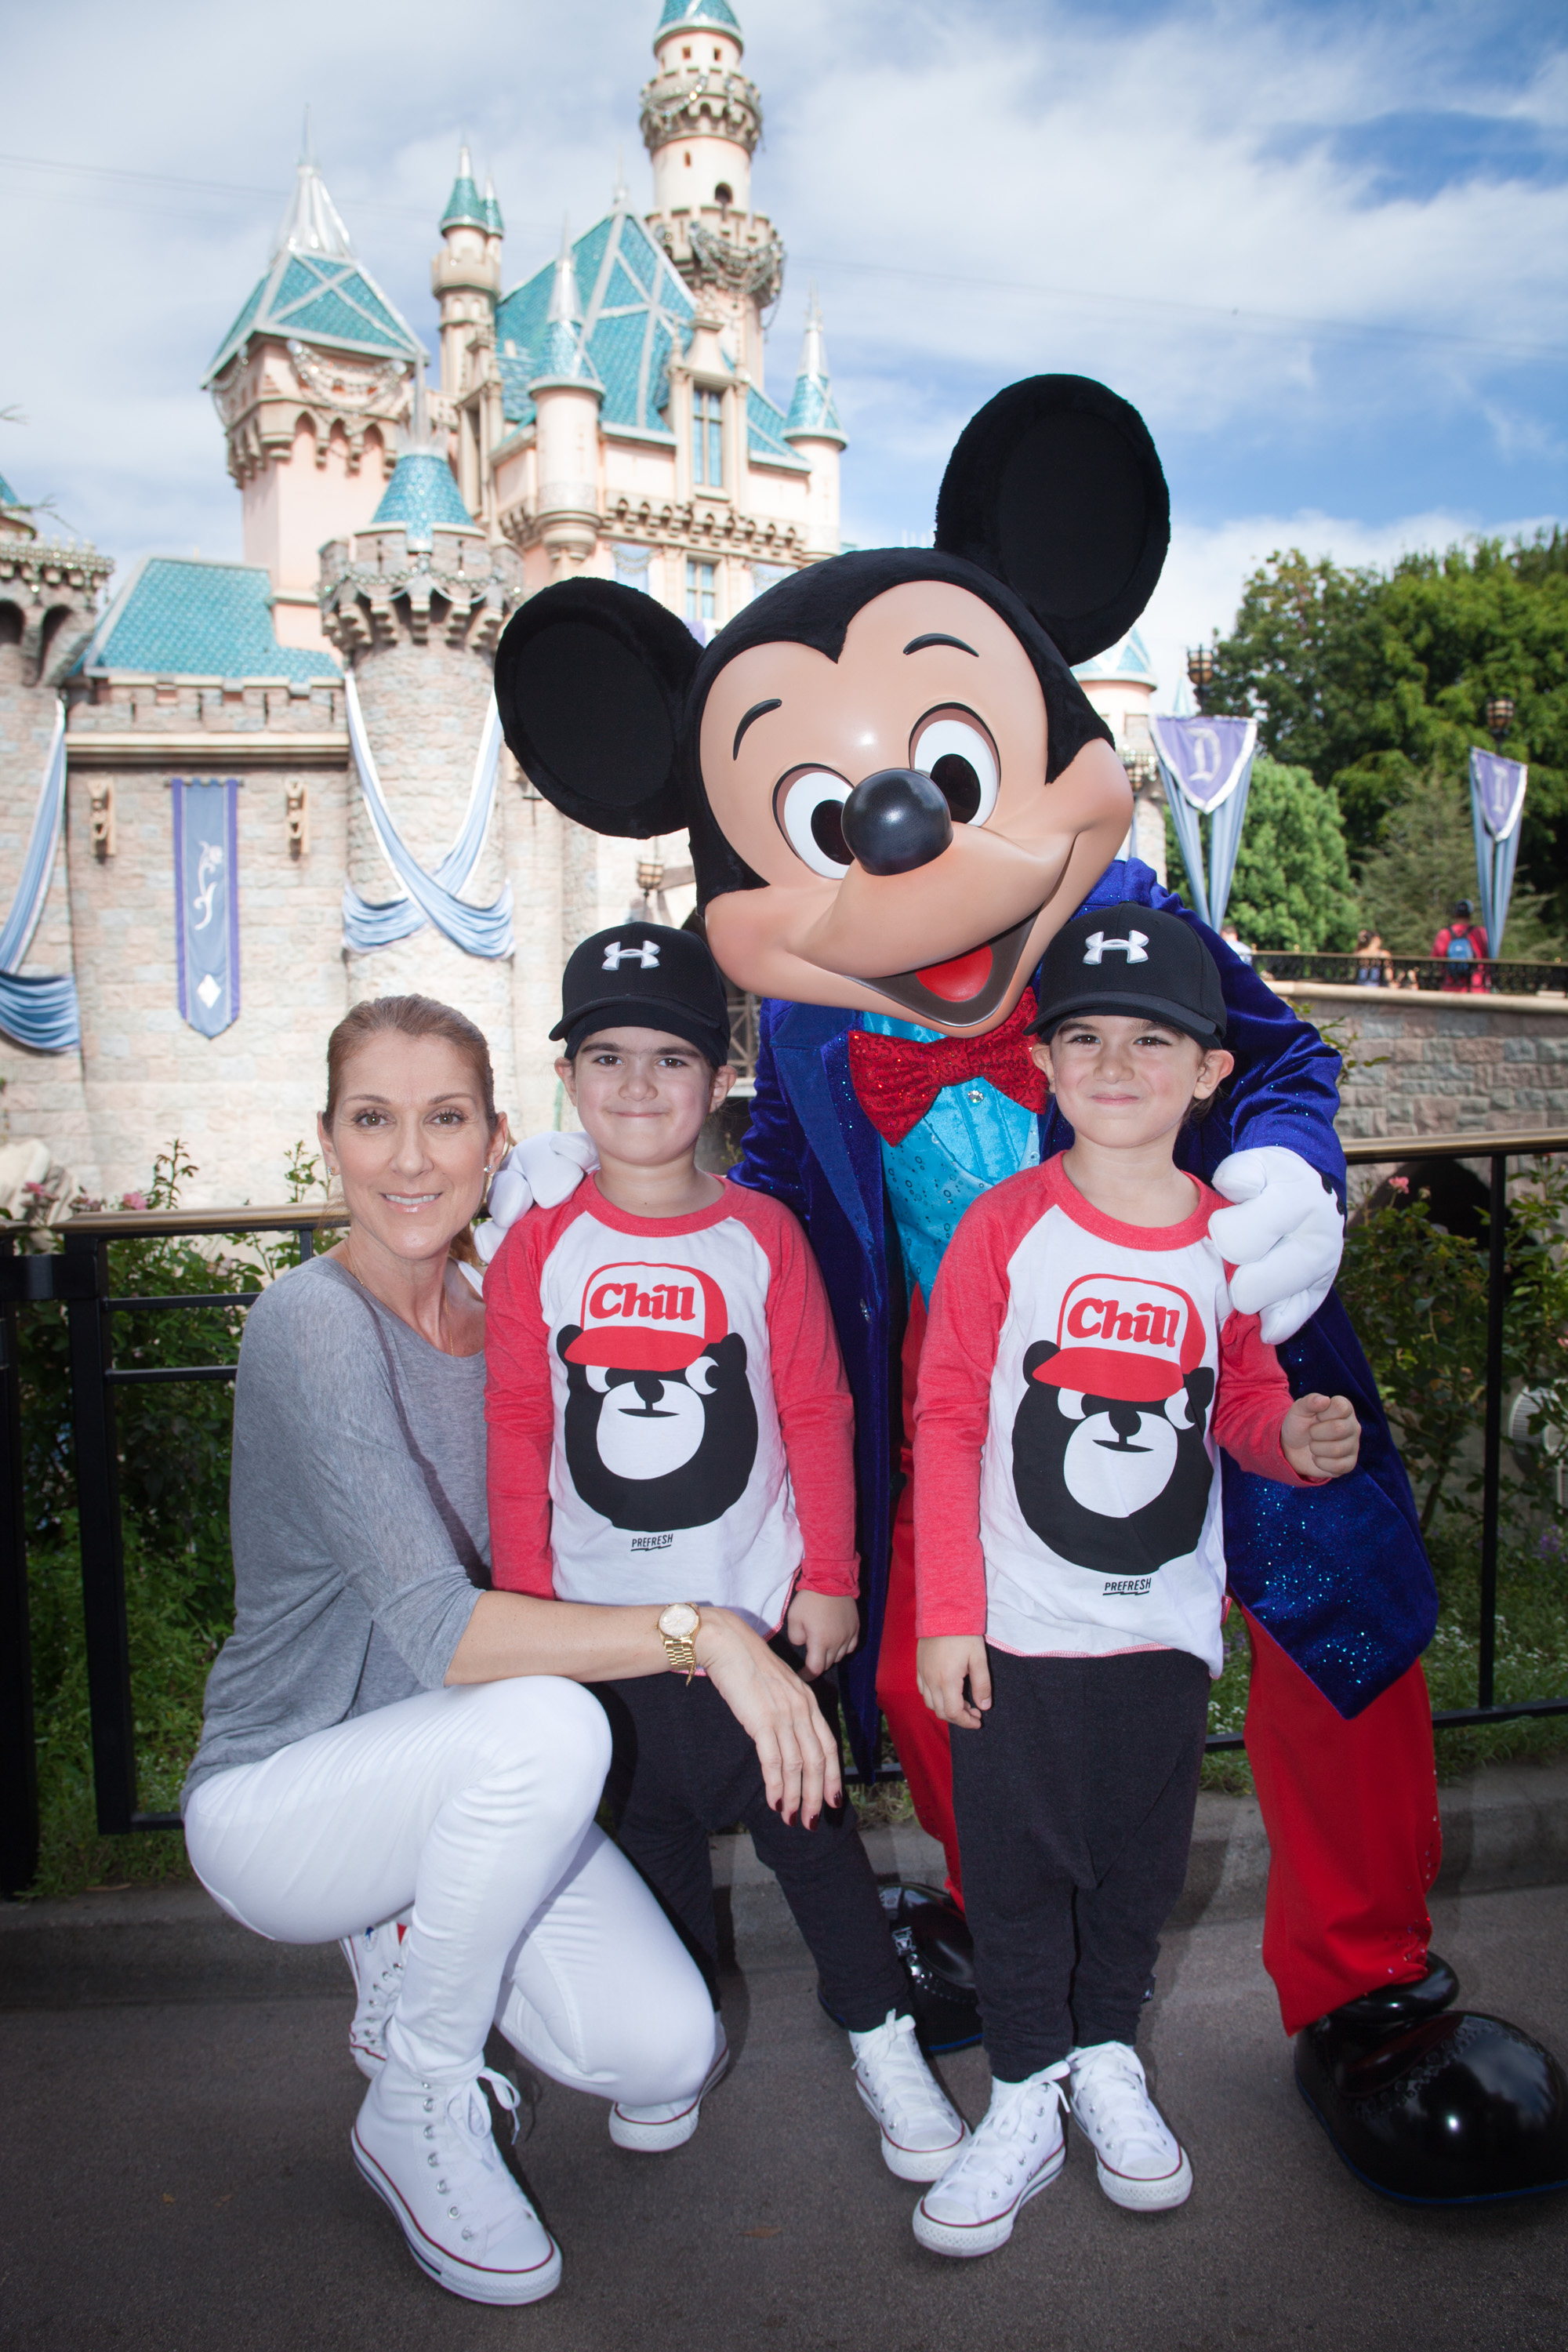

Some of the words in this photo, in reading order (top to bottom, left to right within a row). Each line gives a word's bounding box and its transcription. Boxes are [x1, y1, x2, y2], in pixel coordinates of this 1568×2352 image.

[1185, 727, 1221, 782] D
[590, 1283, 695, 1321] Chill
[1067, 1298, 1180, 1348] Chill
[632, 1534, 673, 1548] PREFRESH
[1105, 1577, 1152, 1591] PREFRESH
